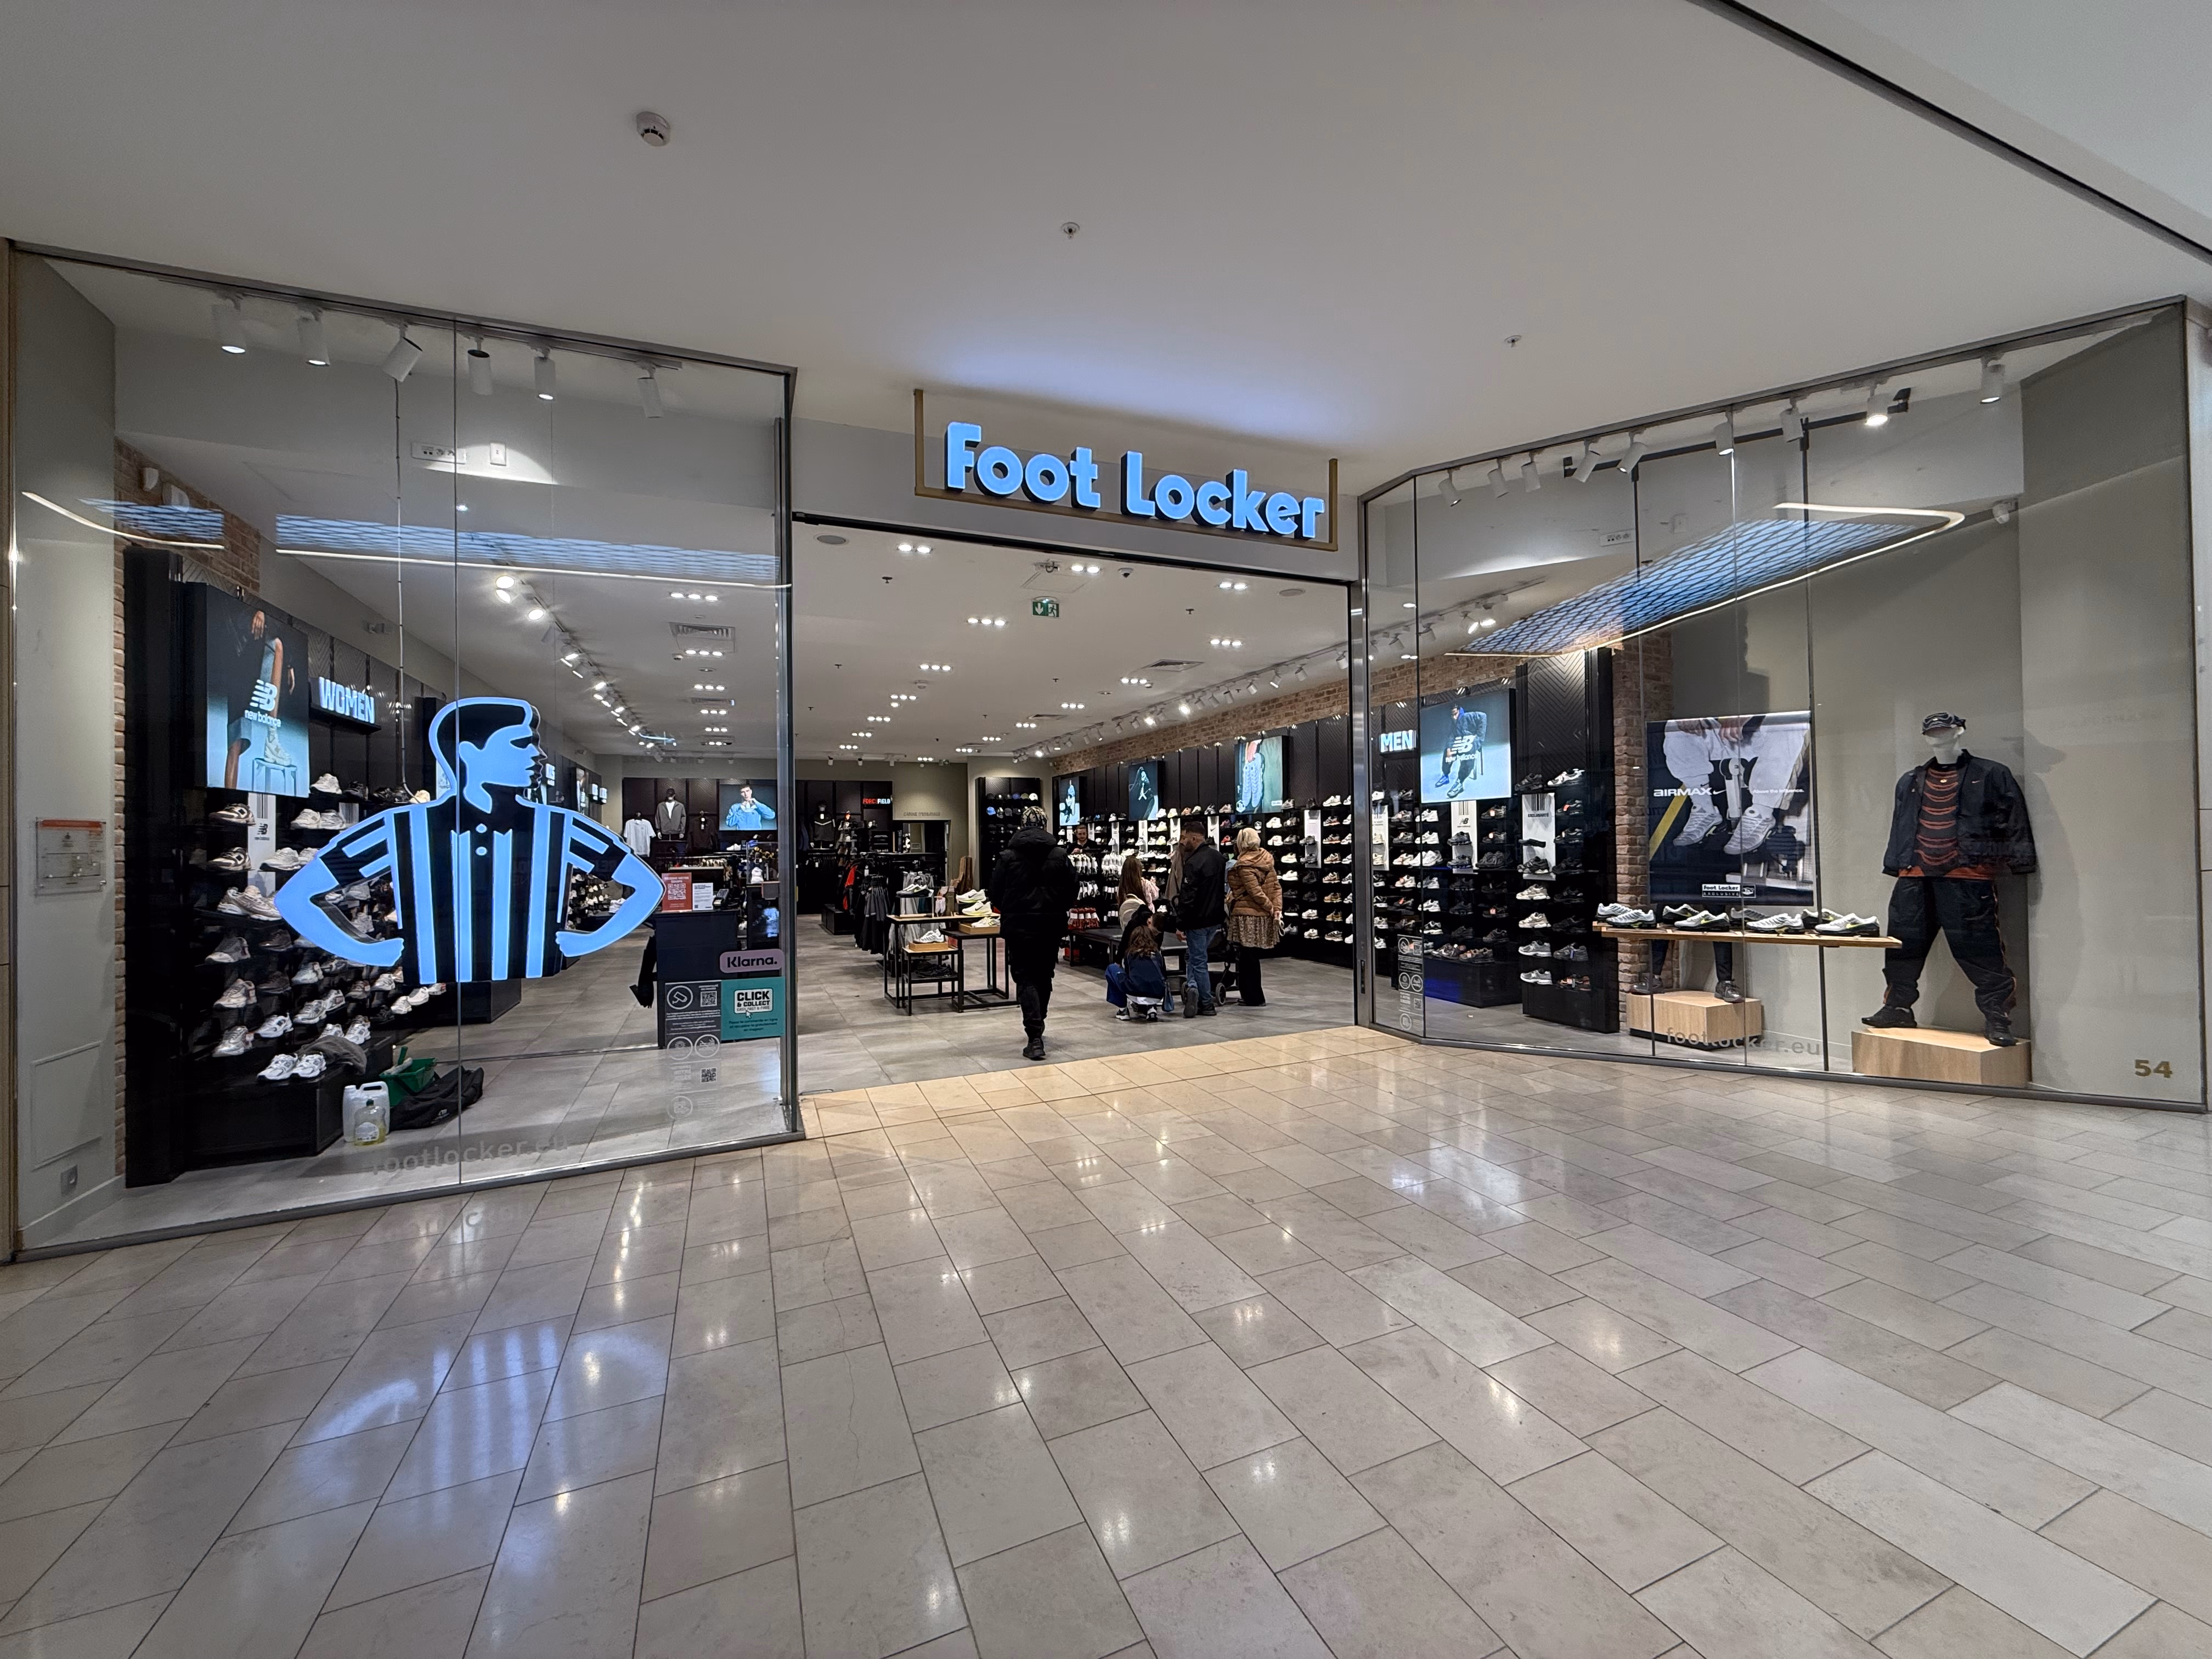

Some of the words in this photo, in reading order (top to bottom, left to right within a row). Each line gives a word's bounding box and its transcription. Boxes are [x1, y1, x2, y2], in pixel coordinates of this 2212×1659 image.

[946, 421, 1101, 509] Foot
[1122, 450, 1325, 538] Locker
[319, 676, 375, 724] WOMEN
[245, 709, 257, 720] new
[257, 711, 281, 727] balance
[1380, 730, 1414, 753] MEN
[727, 956, 777, 968] Klarna.
[737, 991, 770, 1001] CLICK
[2135, 1059, 2173, 1079] 54
